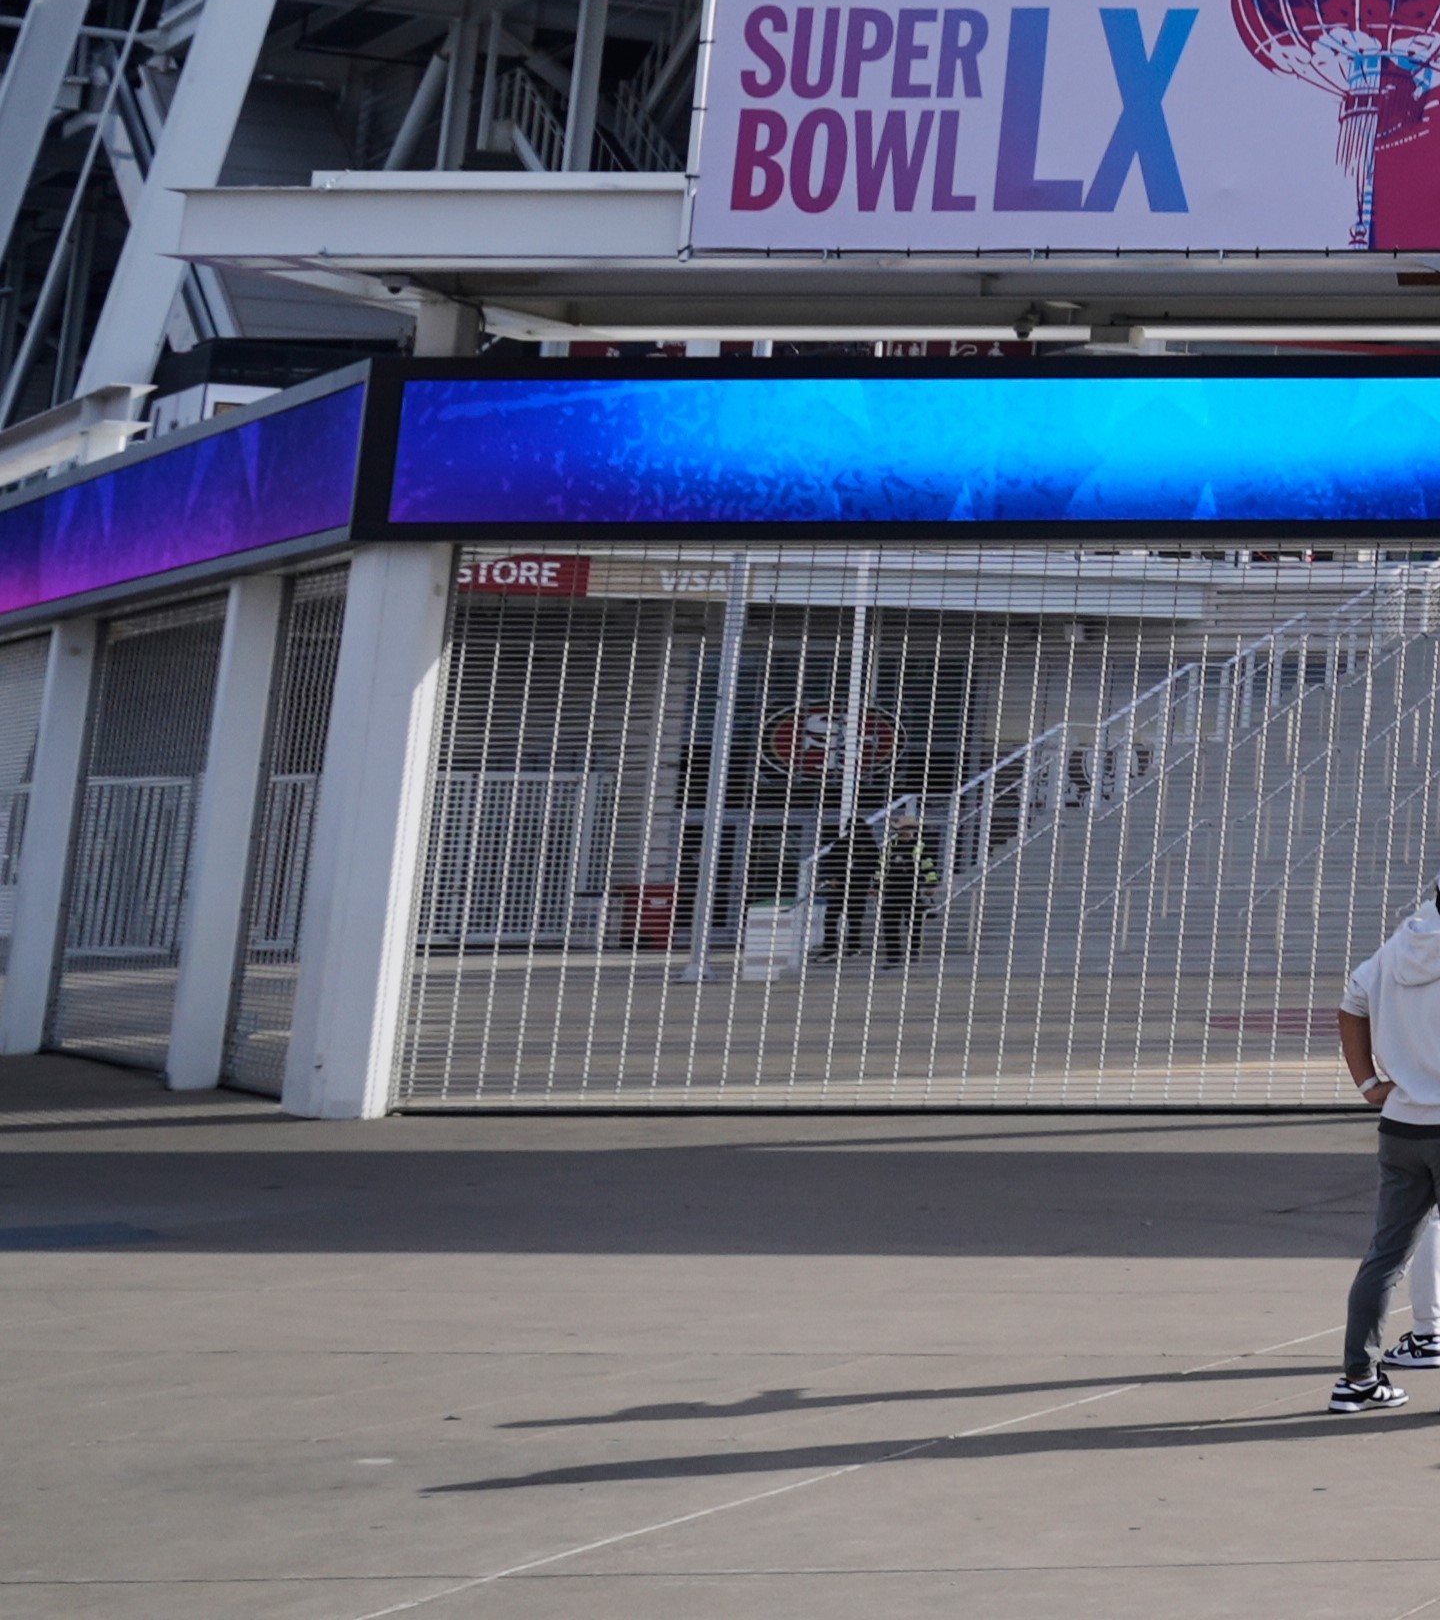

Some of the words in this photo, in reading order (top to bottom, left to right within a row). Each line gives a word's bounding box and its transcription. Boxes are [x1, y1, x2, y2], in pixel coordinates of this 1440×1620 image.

[740, 5, 989, 99] SUPER
[992, 7, 1200, 213] LX
[730, 107, 976, 213] BOWL
[457, 560, 561, 587] STORE
[659, 570, 727, 592] VISA
